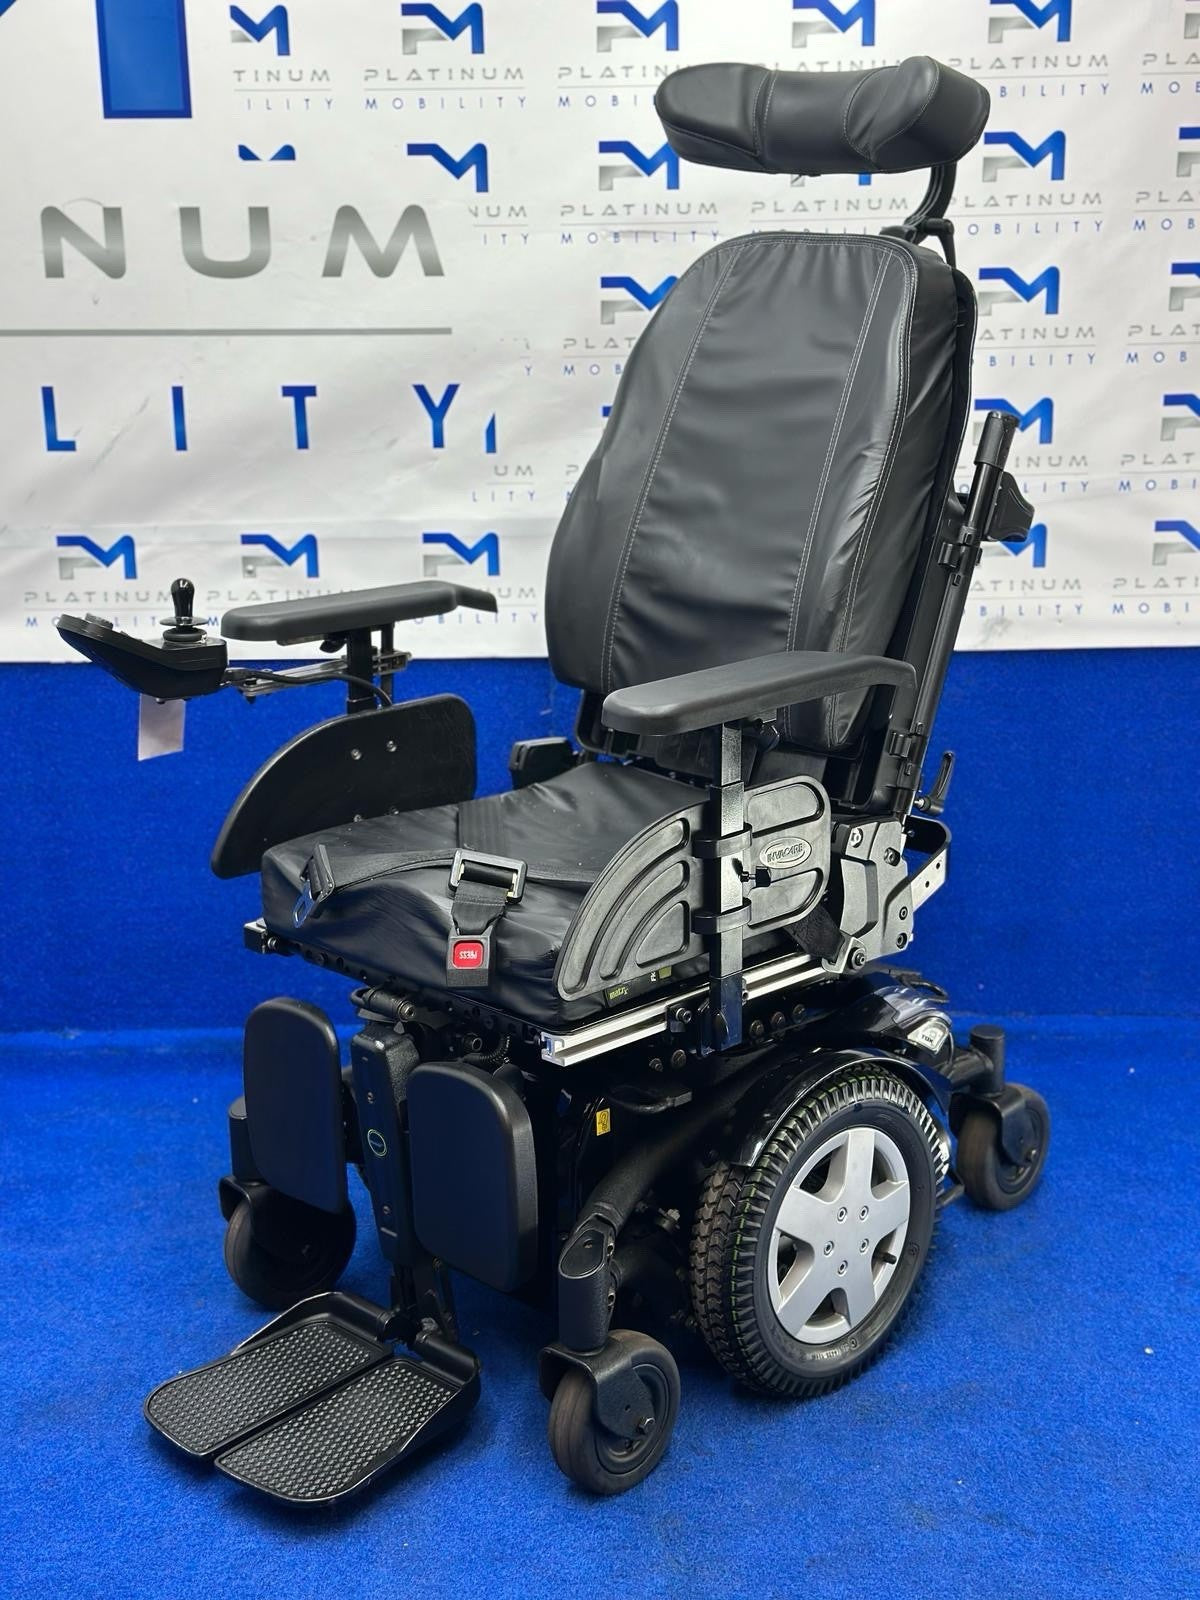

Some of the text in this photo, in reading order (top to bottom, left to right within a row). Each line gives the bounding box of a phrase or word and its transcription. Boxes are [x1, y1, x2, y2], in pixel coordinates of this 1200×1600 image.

[949, 54, 1109, 70] PLATINUM
[364, 68, 524, 81] PLATINUM
[365, 98, 526, 110] MOBILITY
[558, 95, 656, 107] MOBI
[560, 202, 718, 217] PLATINUM
[752, 198, 908, 213] PLATINUM
[561, 231, 719, 245] MOBILITY
